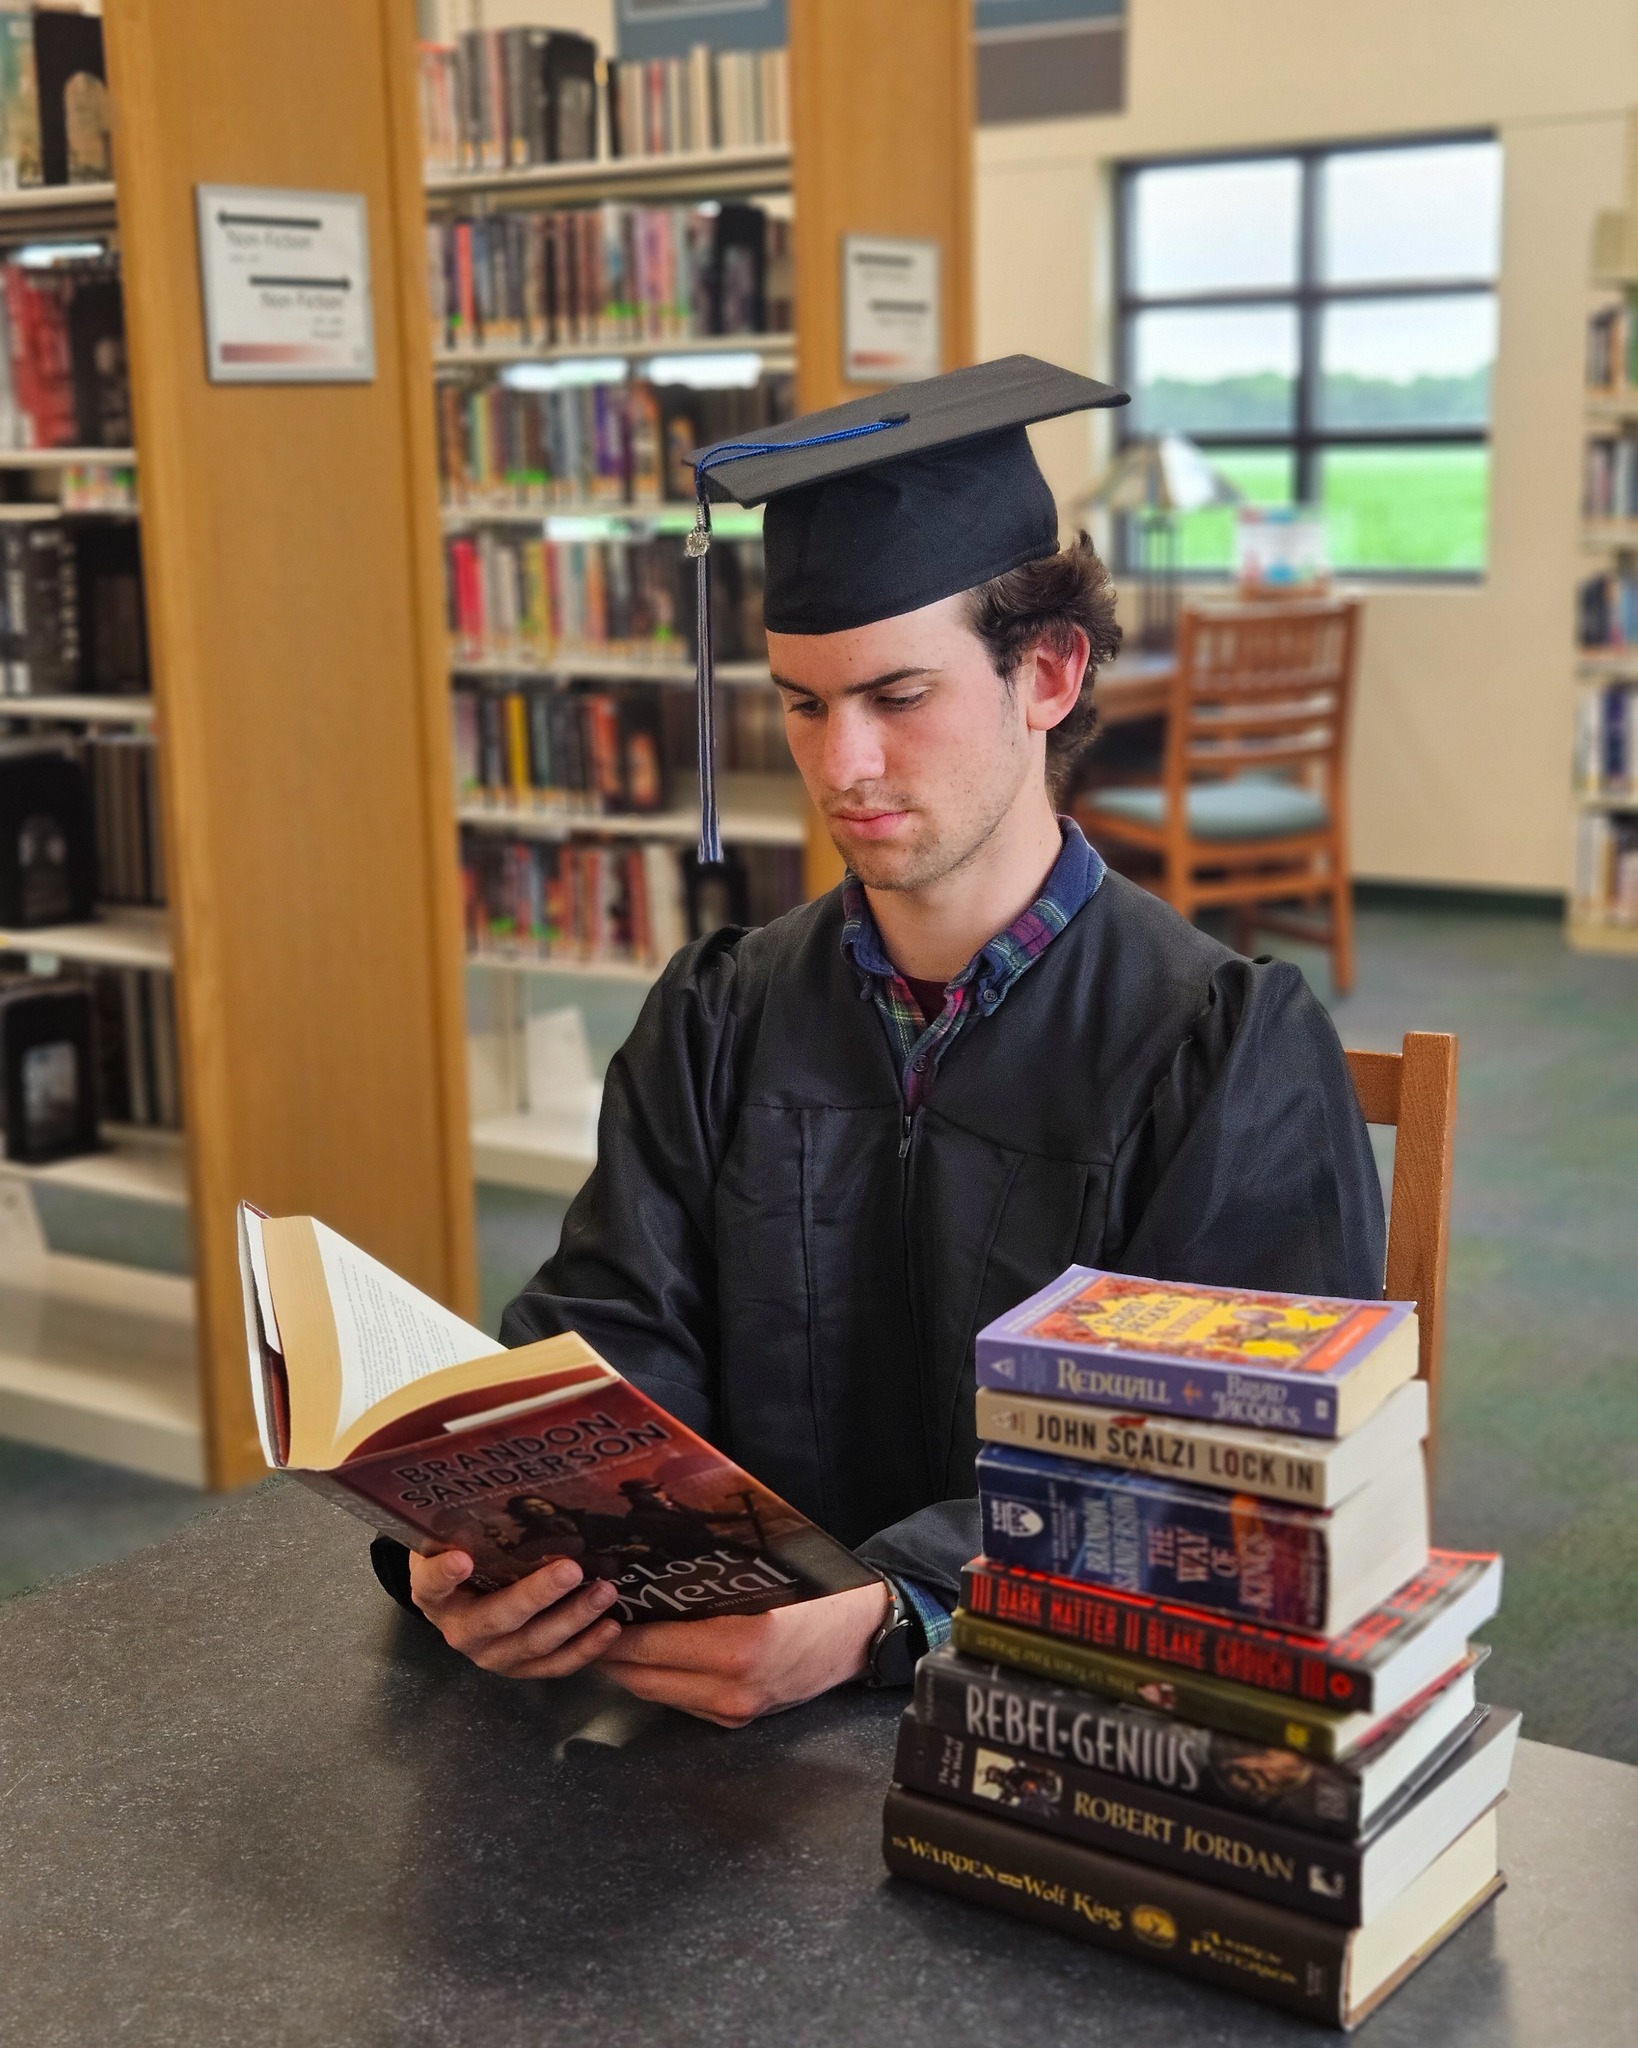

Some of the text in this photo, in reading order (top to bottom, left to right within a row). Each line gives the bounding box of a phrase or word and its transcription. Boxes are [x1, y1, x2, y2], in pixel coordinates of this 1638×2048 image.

[1057, 1358, 1171, 1405] REDWALL
[394, 1412, 622, 1485] BRANDON
[401, 1422, 671, 1509] SANDERSON
[1036, 1414, 1097, 1449] JOHN
[1108, 1428, 1195, 1470] SCALZI
[1210, 1449, 1277, 1484] LOCK
[1287, 1463, 1314, 1491] IN
[1149, 1523, 1175, 1568] THE
[1176, 1526, 1209, 1582] WAY
[1211, 1547, 1239, 1579] OF
[616, 1556, 799, 1622] Metal
[997, 1579, 1293, 1691] DARK MATTER BLAKE CROUCH
[1072, 1712, 1199, 1790] GENIUS
[1074, 1791, 1296, 1882] ROBERT JORDAN
[907, 1836, 997, 1879] WARDEN
[1022, 1875, 1066, 1905] Wolf
[1072, 1891, 1123, 1931] King
